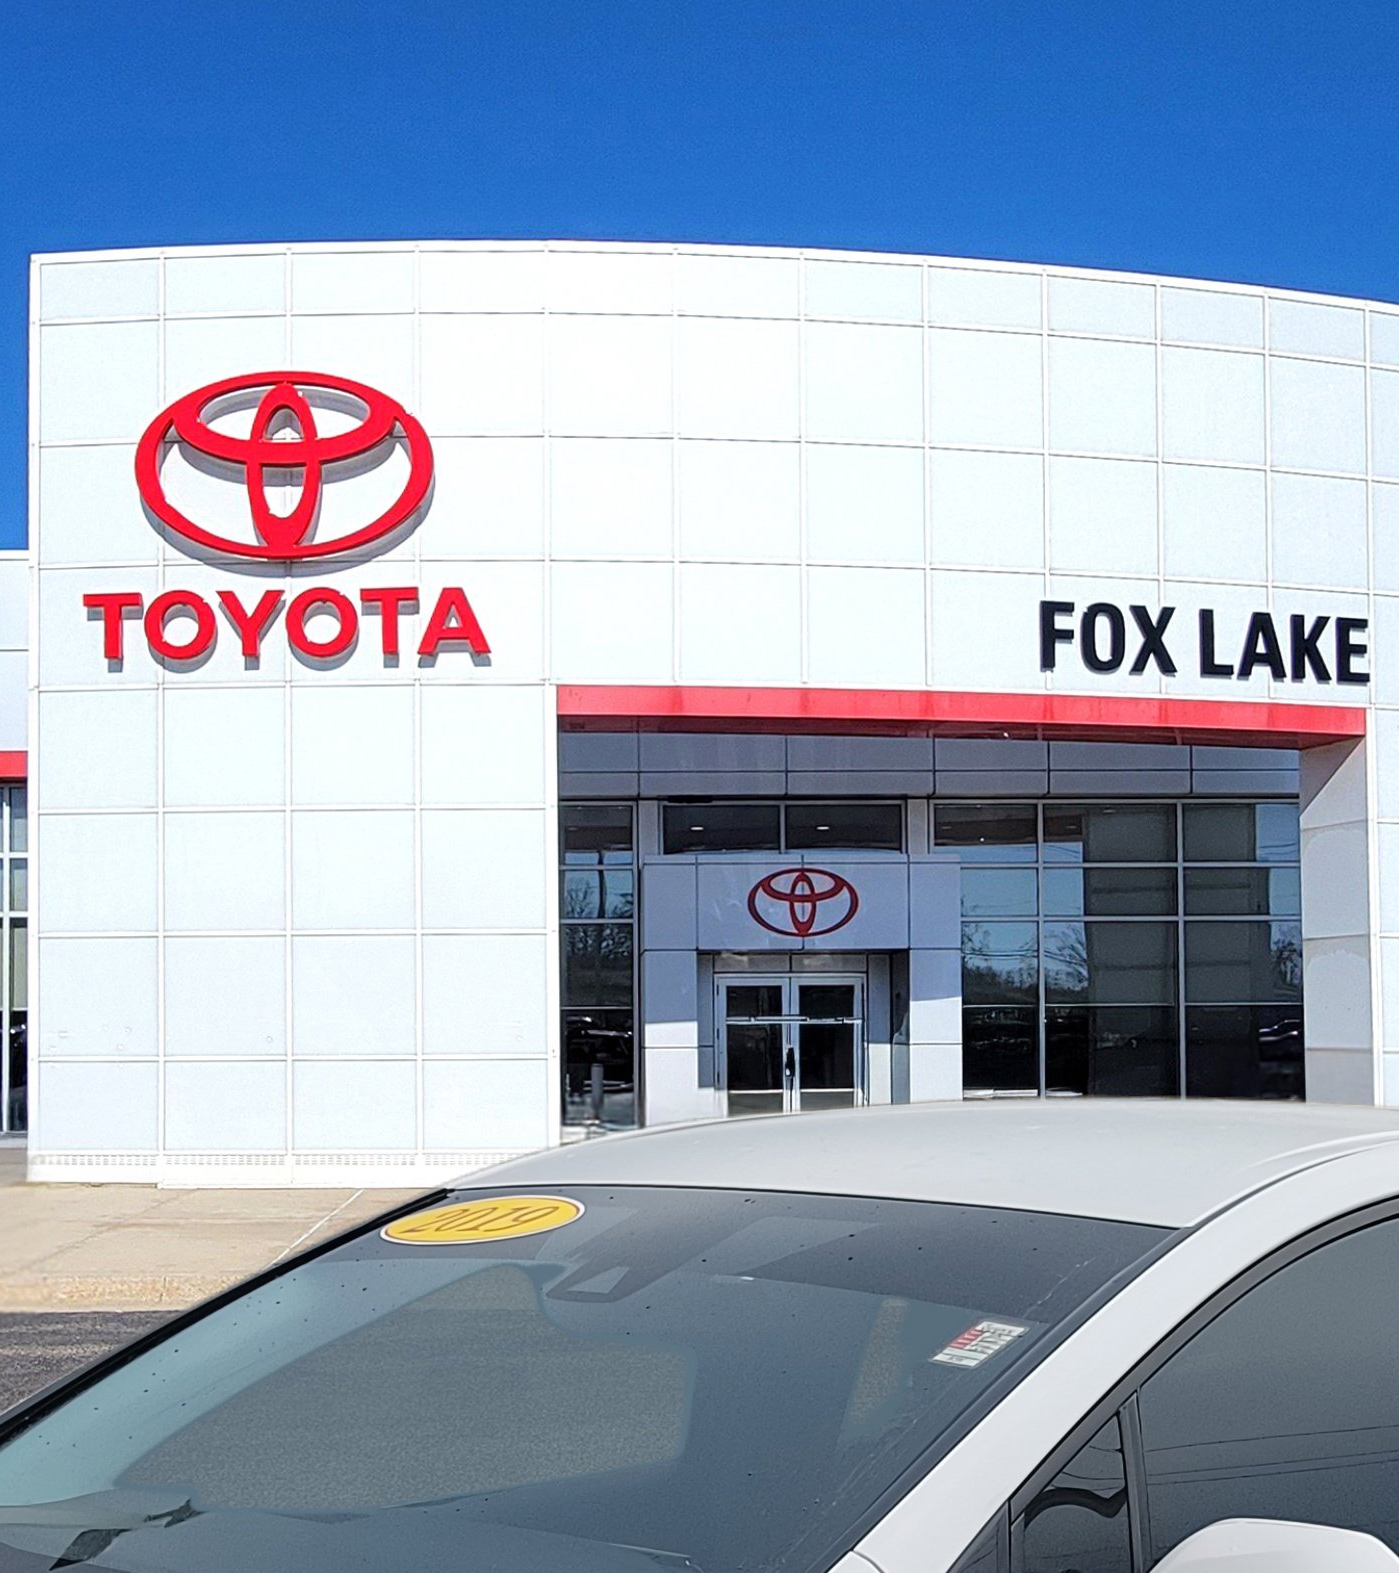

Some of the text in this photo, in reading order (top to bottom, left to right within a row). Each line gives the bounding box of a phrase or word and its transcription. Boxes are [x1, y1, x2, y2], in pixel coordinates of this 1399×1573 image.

[82, 586, 492, 664] TOYOTA
[1039, 600, 1371, 685] FOX LAKE
[399, 1205, 559, 1234] 2019
